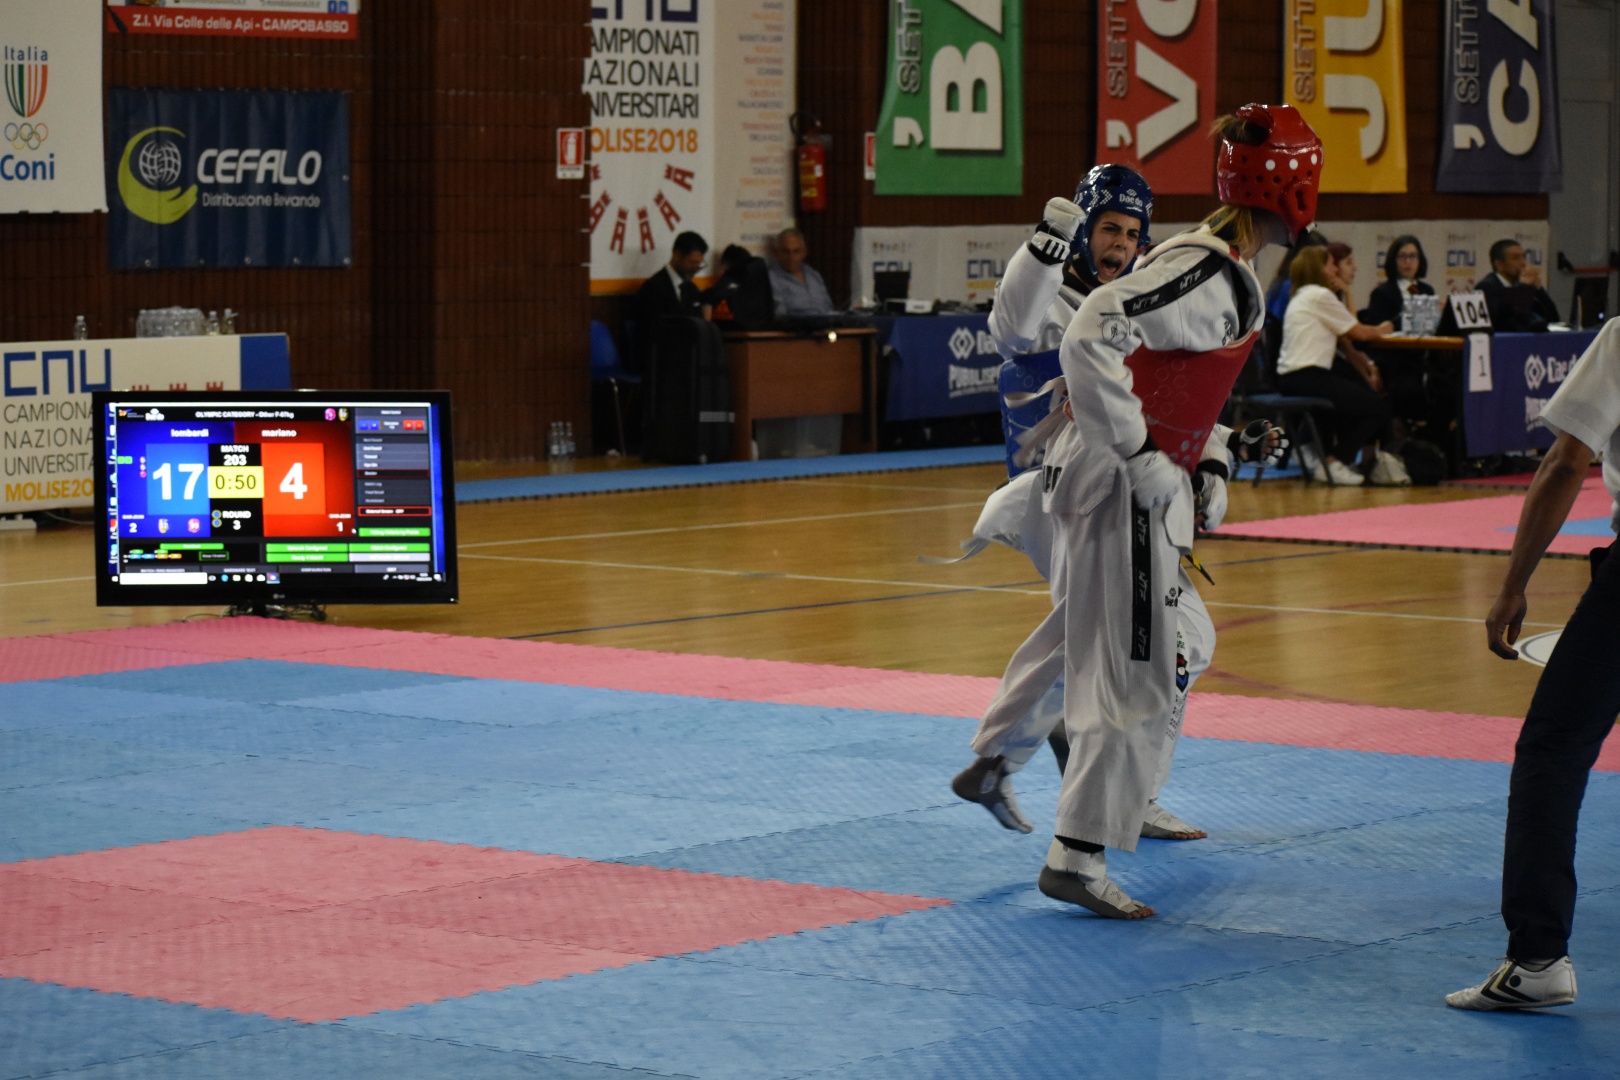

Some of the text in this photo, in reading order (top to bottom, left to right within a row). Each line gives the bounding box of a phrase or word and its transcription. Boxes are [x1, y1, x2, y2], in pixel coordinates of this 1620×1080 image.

[154, 16, 173, 28] Via
[175, 16, 202, 29] Colle
[262, 18, 349, 33] CAMPOBASSO
[4, 46, 49, 61] Italia
[0, 154, 55, 180] Coni
[197, 149, 322, 185] CEFALO
[203, 192, 321, 208] Distribuzione Bevande
[1455, 301, 1490, 325] 104
[171, 429, 209, 437] lombardi
[262, 429, 297, 437] mariano
[221, 445, 249, 453] MATCH
[223, 454, 247, 466] 203
[153, 463, 205, 500] 17
[215, 474, 257, 490] 0:50
[279, 462, 308, 500] 4
[129, 522, 138, 533] 2
[233, 520, 241, 530] 3
[336, 522, 343, 532] 1
